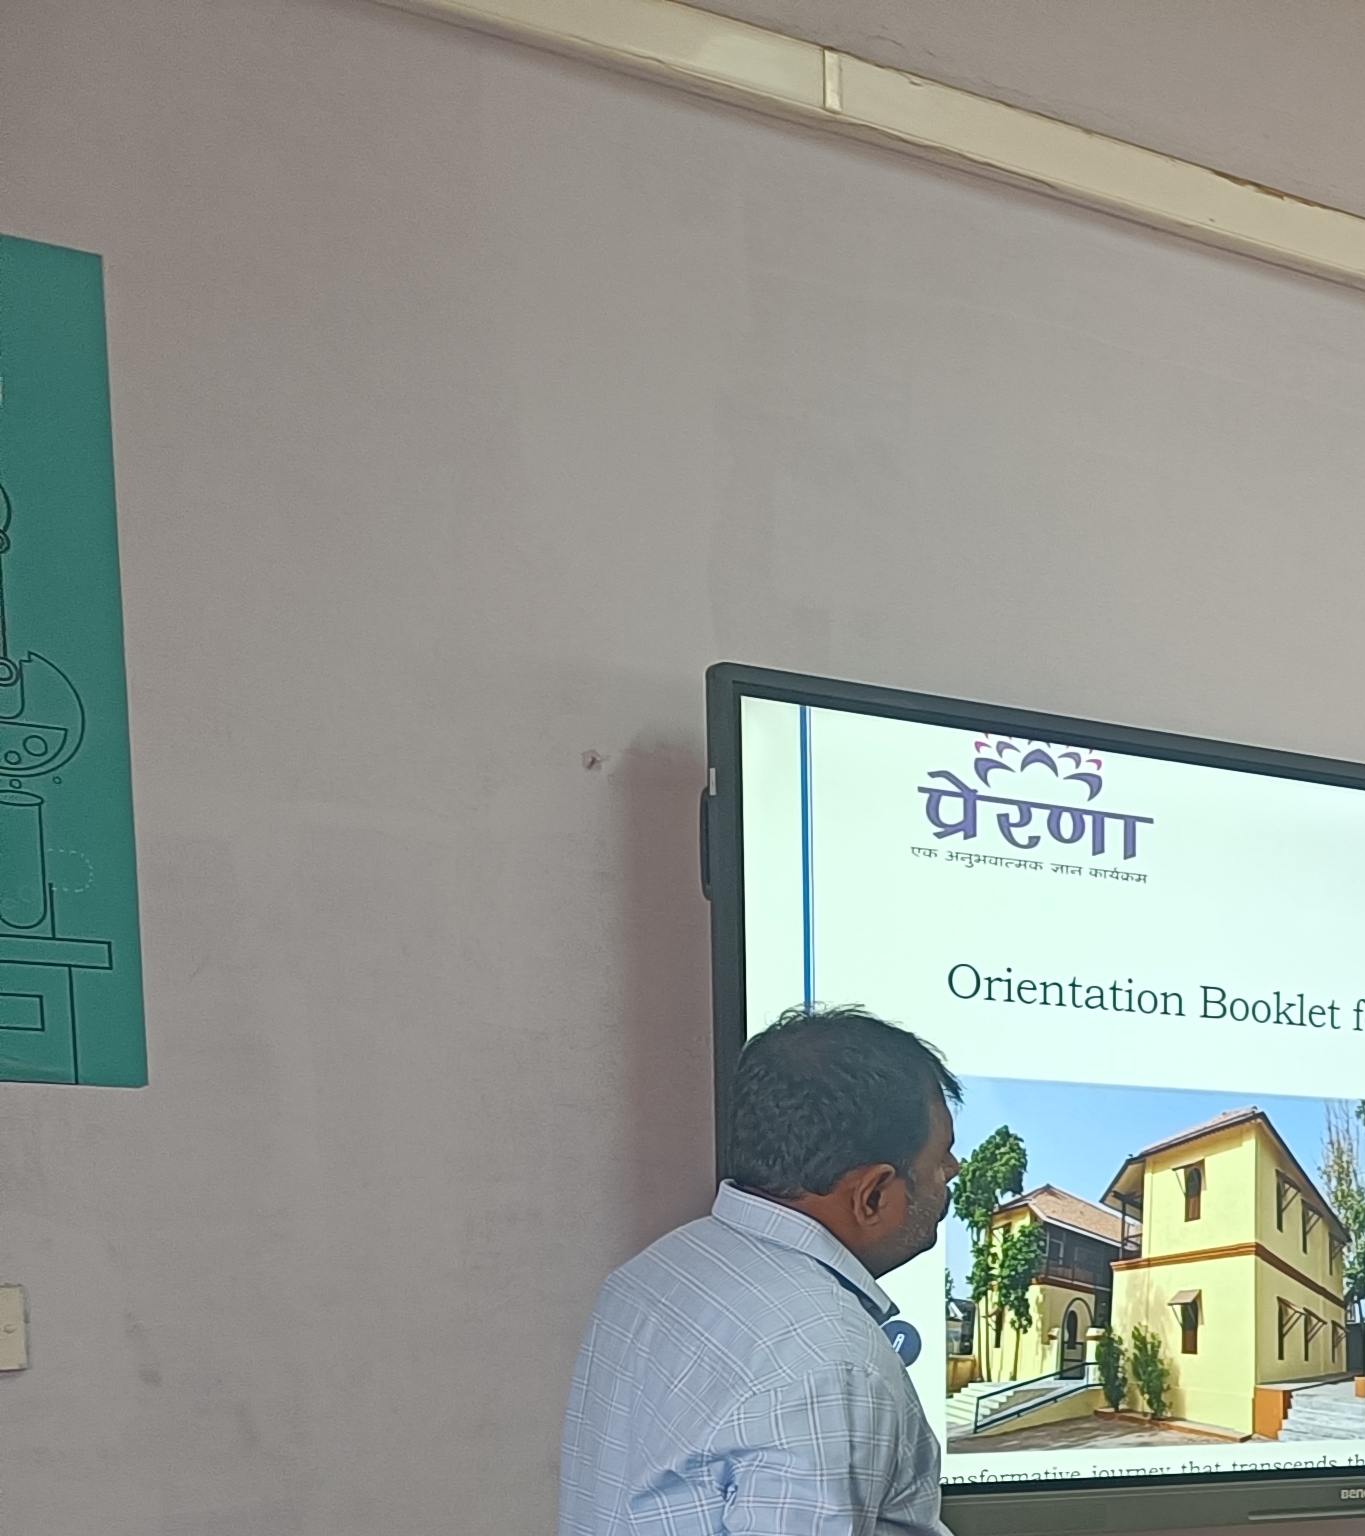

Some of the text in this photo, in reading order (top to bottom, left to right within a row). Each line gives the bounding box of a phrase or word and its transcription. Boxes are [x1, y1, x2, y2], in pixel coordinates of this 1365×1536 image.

[917, 770, 1154, 860] प्रेरणा
[910, 846, 938, 858] एक
[945, 850, 1043, 871] अनुभवात्मक
[1050, 863, 1083, 877] ज्ञान
[948, 964, 1186, 1016] Orientation
[1199, 985, 1341, 1029] Booklet
[939, 1468, 1081, 1484] ansformative
